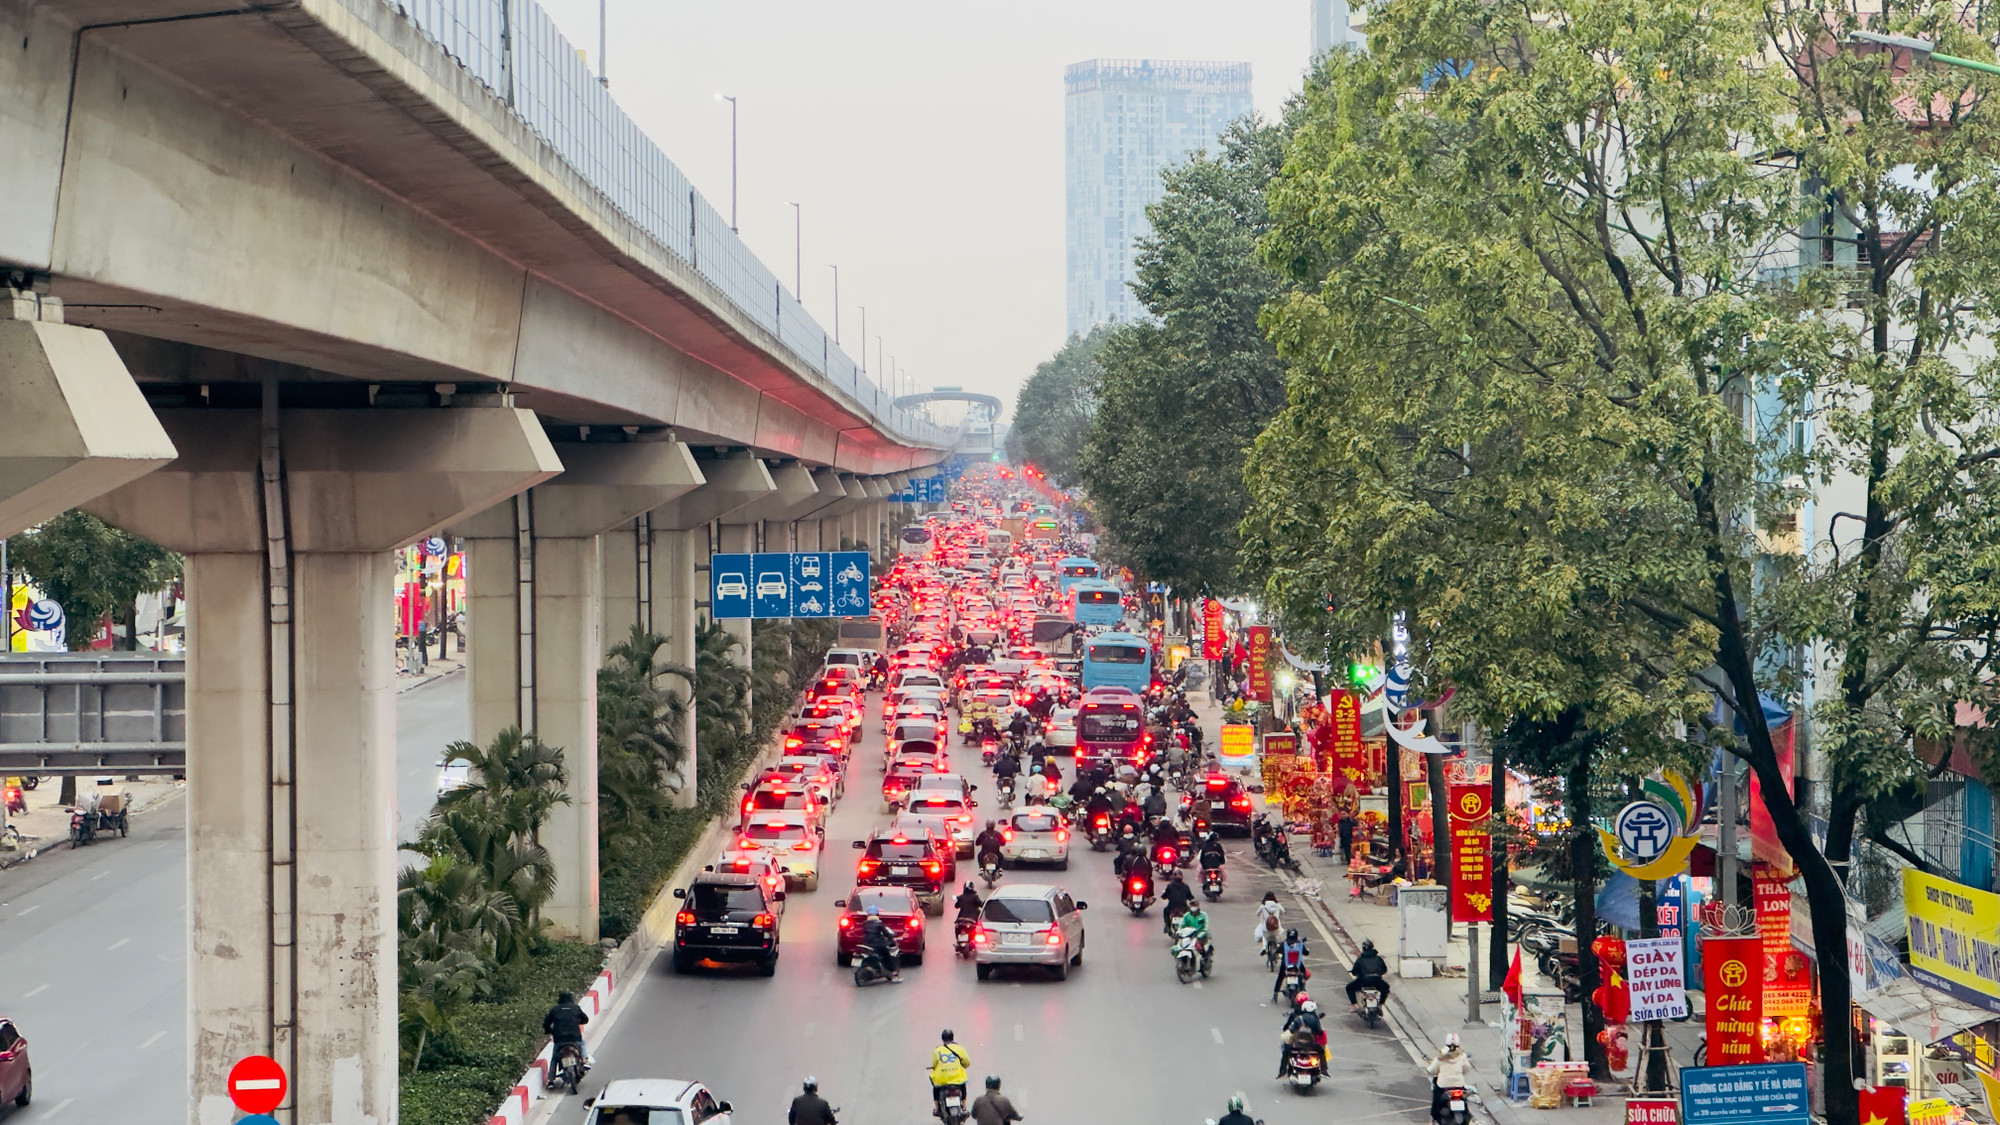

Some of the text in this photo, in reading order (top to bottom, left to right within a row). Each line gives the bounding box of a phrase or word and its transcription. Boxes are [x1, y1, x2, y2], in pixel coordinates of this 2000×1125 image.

[1336, 709, 1356, 718] 3-2
[1926, 885, 1940, 904] SHOP
[1632, 949, 1677, 965] GIÀY
[1634, 966, 1677, 978] DÉP DA
[1632, 979, 1681, 992] DÂY LƯNG
[1642, 993, 1674, 1004] VÍ DA
[1716, 995, 1752, 1011] Chúc
[1634, 1007, 1653, 1020] SỬA
[1671, 1006, 1684, 1017] DA
[1716, 1017, 1754, 1037] mừng
[1722, 1039, 1751, 1054] năm
[939, 1052, 957, 1063] be
[1689, 1077, 1802, 1094] TRƯỜNG CAO ĐẲNG Y TẾ HÀ ĐÔNG
[1712, 1096, 1723, 1104] TÂM
[1724, 1096, 1738, 1104] THỰC
[1770, 1092, 1785, 1100] CHỮA
[1785, 1092, 1799, 1100] BỆNH
[1628, 1104, 1676, 1122] SỬA CHỮA
